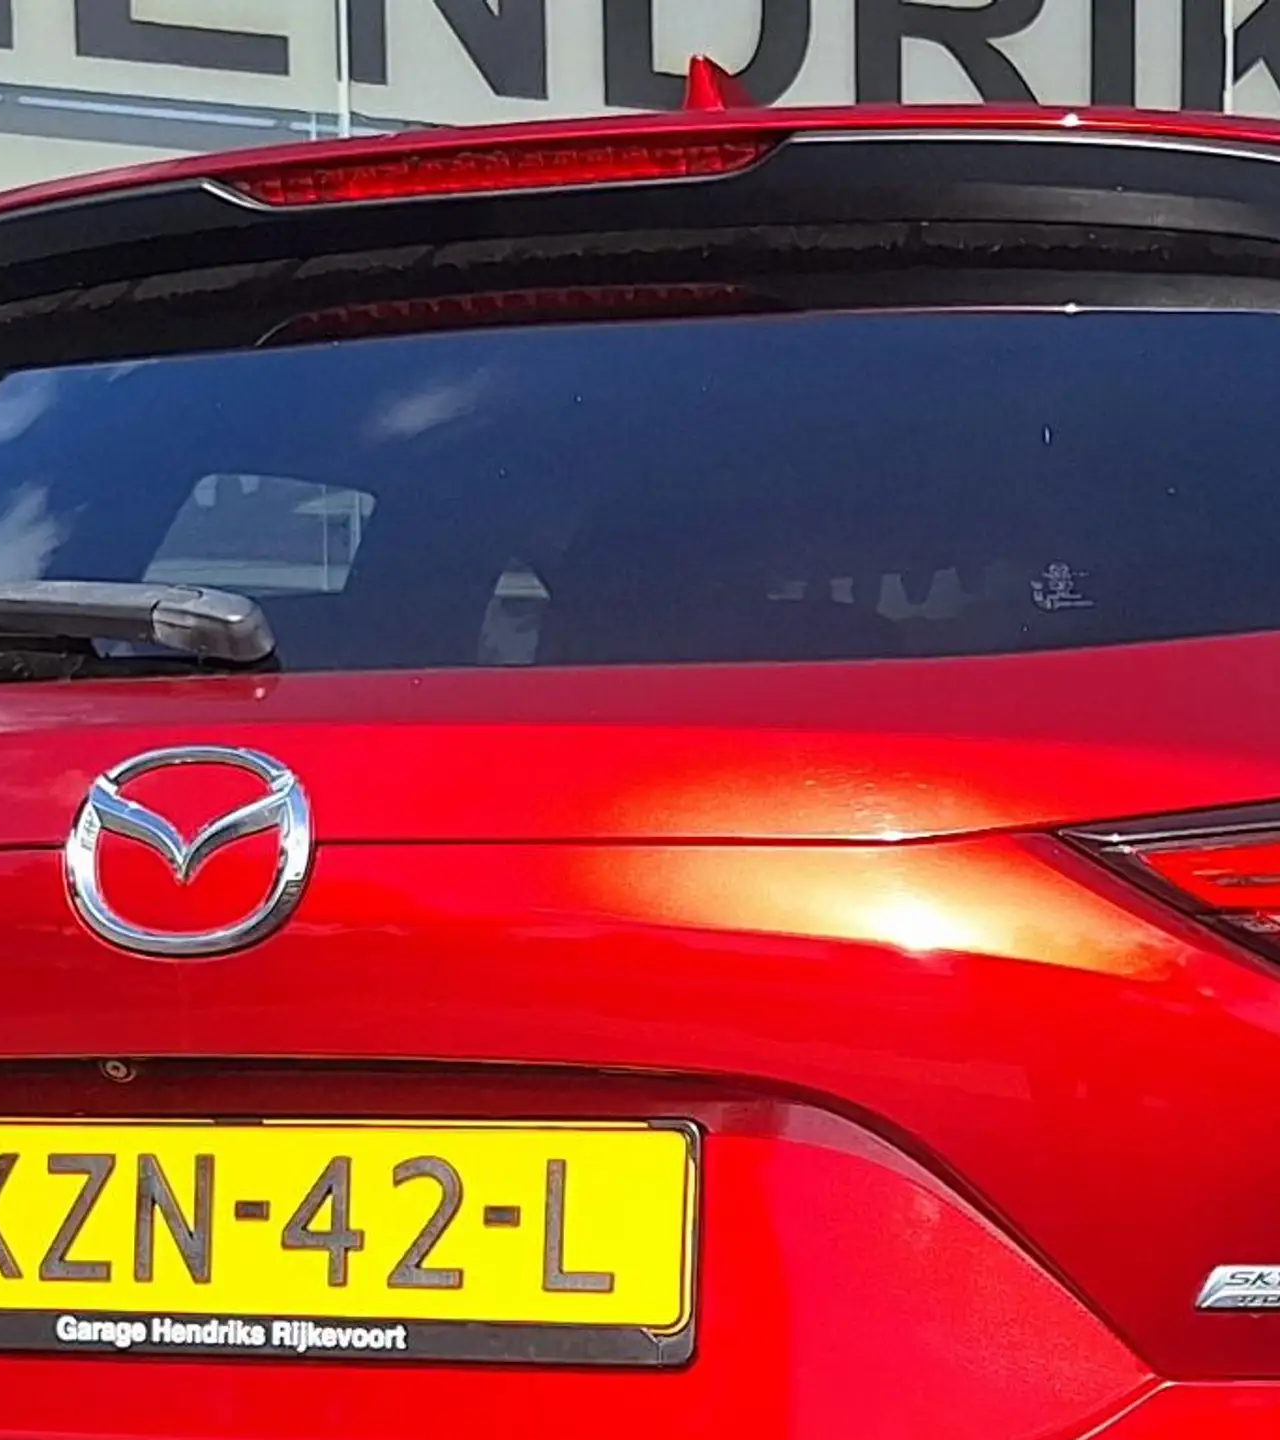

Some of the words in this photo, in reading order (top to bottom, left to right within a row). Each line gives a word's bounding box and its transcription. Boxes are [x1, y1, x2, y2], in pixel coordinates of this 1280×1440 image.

[56, 1315, 146, 1348] Garage
[151, 1317, 266, 1347] Hendriks
[271, 1319, 407, 1352] Rijkevoort
